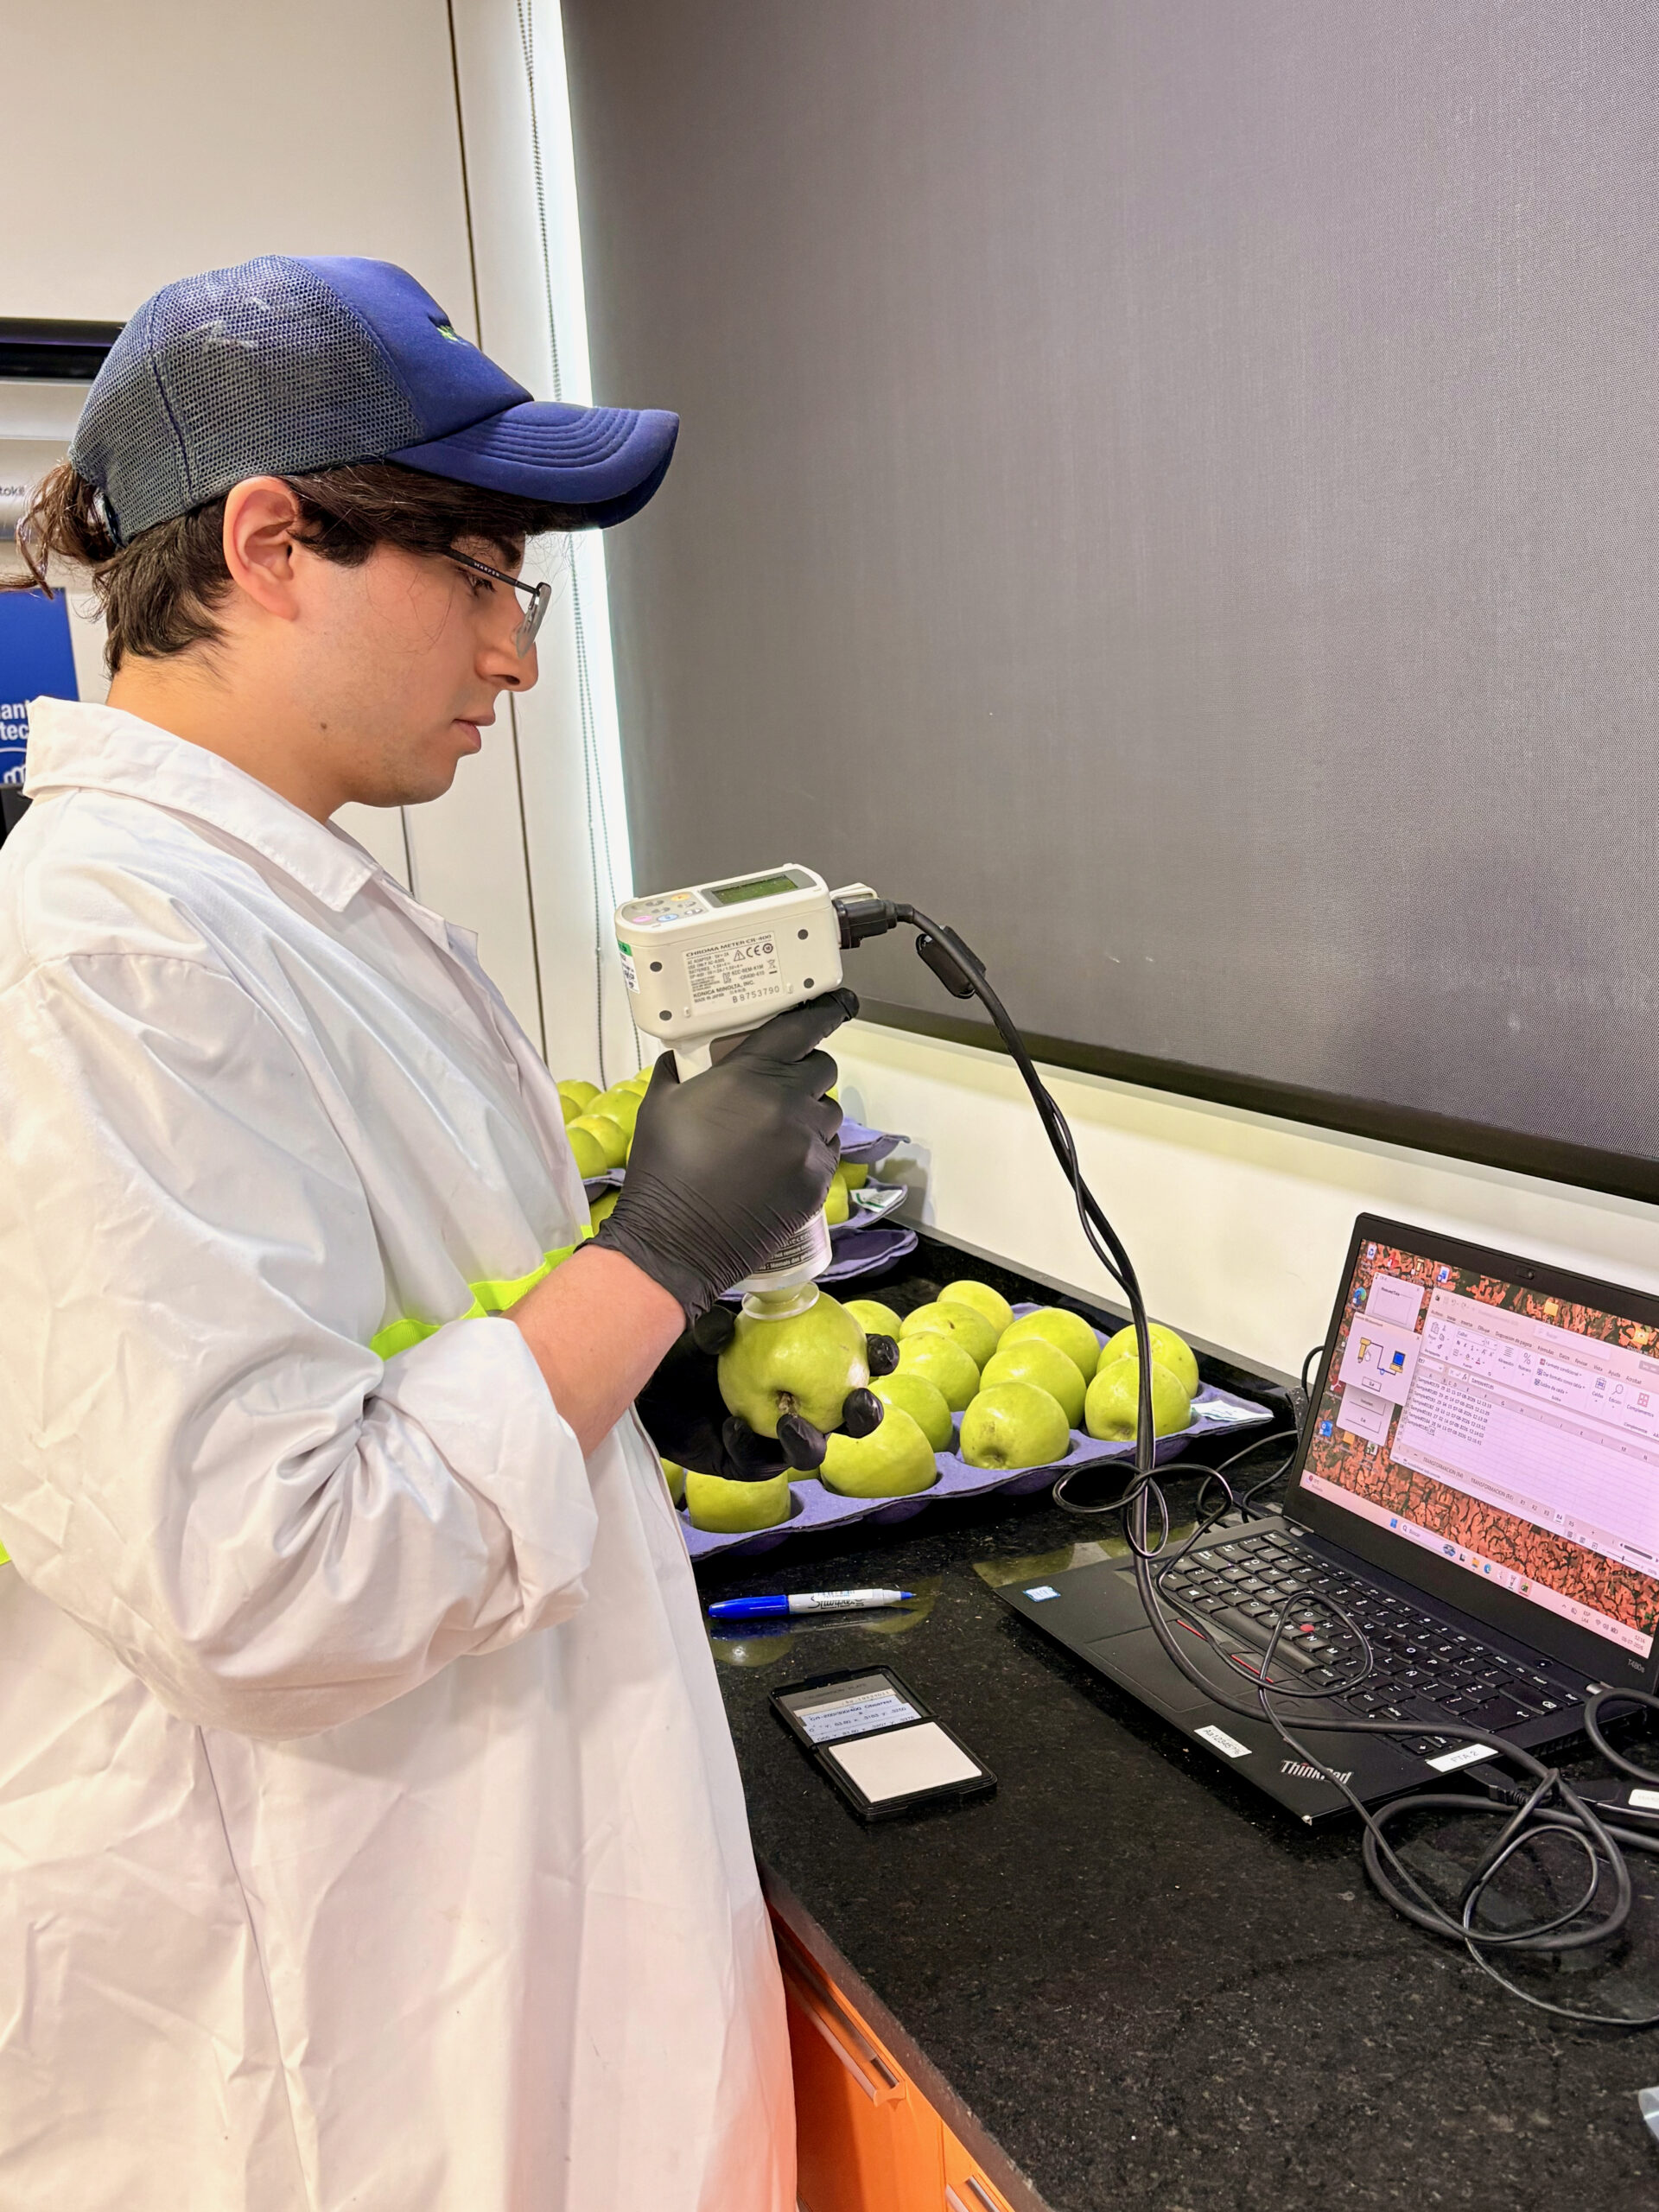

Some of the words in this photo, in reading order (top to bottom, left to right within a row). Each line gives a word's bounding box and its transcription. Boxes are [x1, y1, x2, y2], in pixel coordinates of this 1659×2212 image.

[685, 946, 719, 957] CHROMA
[720, 940, 745, 950] METER
[746, 934, 772, 944] CR-400
[693, 989, 715, 998] KONICA
[715, 983, 743, 993] MINOLTA,
[1626, 1376, 1643, 1385] Acrobat
[1627, 1659, 1645, 1674] T480s
[1451, 1752, 1471, 1764] FTA
